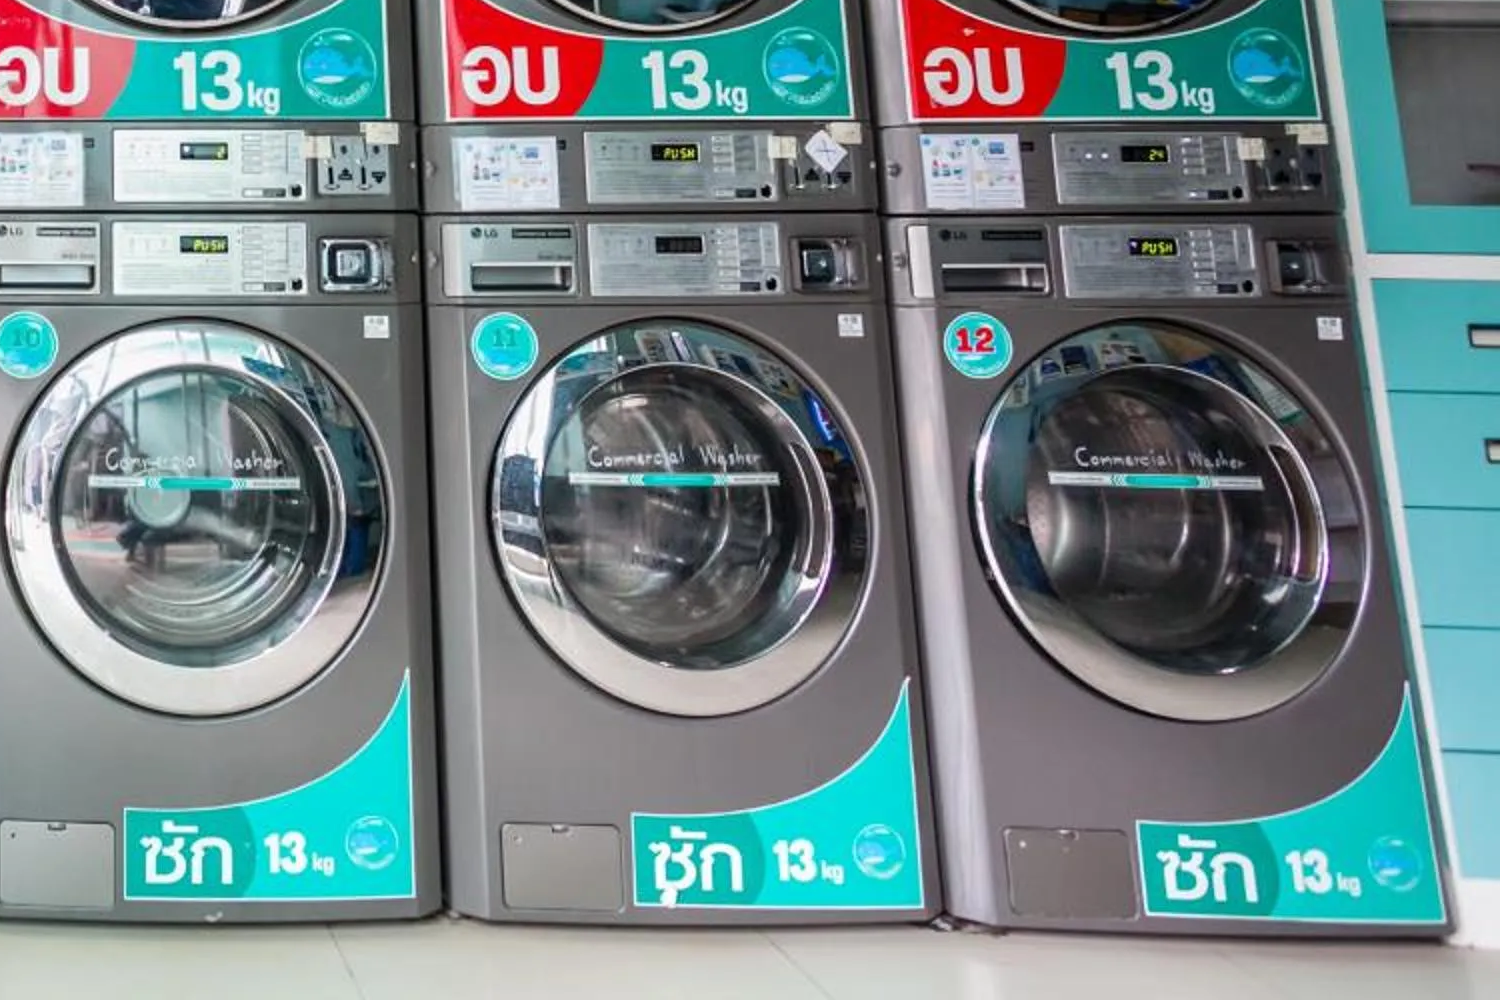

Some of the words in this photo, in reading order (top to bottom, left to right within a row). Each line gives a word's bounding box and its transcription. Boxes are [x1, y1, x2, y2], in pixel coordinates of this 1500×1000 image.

[461, 46, 560, 106] อบ
[922, 46, 1025, 106] อบ
[663, 146, 697, 159] PUSH
[193, 238, 229, 252] PUSH
[1141, 240, 1174, 255] PUSH
[13, 328, 41, 348] 10
[492, 328, 518, 348] 11
[954, 326, 996, 354] 12
[588, 445, 686, 470] Commercial
[699, 447, 764, 468] Washer
[1074, 446, 1173, 469] Commercial
[1187, 449, 1247, 470] Washer
[140, 820, 233, 885] ซัก
[1155, 833, 1258, 904] ซัก
